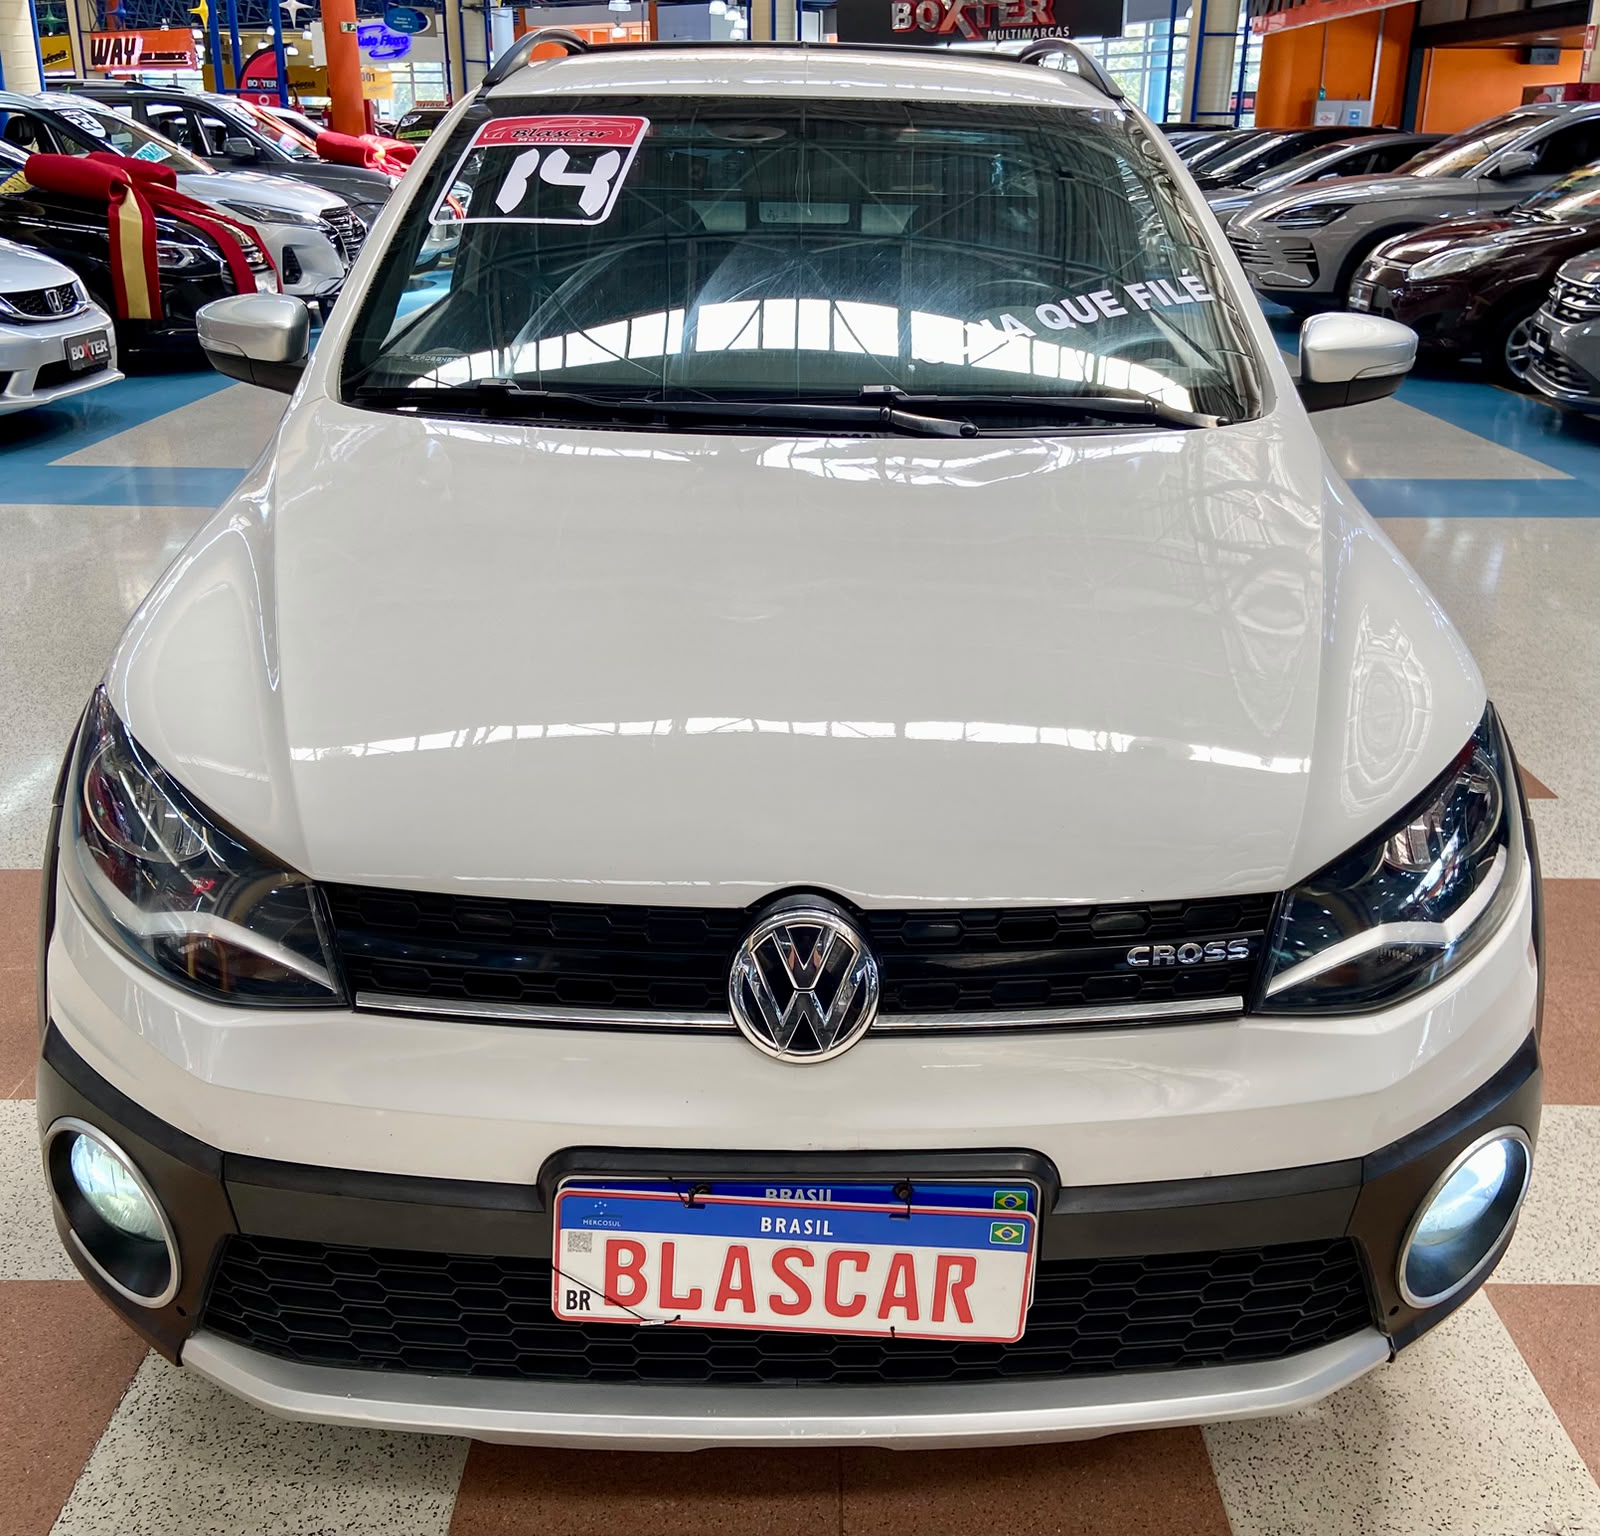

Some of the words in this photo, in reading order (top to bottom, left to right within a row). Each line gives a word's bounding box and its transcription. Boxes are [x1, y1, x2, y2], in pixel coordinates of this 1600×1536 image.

[891, 0, 1056, 41] BOXTER
[987, 26, 1070, 41] MULTIMARCAS
[91, 38, 137, 65] WAY
[495, 148, 621, 216] 14
[1035, 289, 1128, 330] QUE
[1123, 268, 1215, 311] FILÉ
[71, 339, 109, 361] BOXTER
[1127, 938, 1250, 967] CROSS
[582, 1219, 622, 1228] MERCOSUL
[760, 1216, 834, 1236] BRASIL
[604, 1238, 977, 1324] BLASCAR
[566, 1289, 591, 1311] BR
